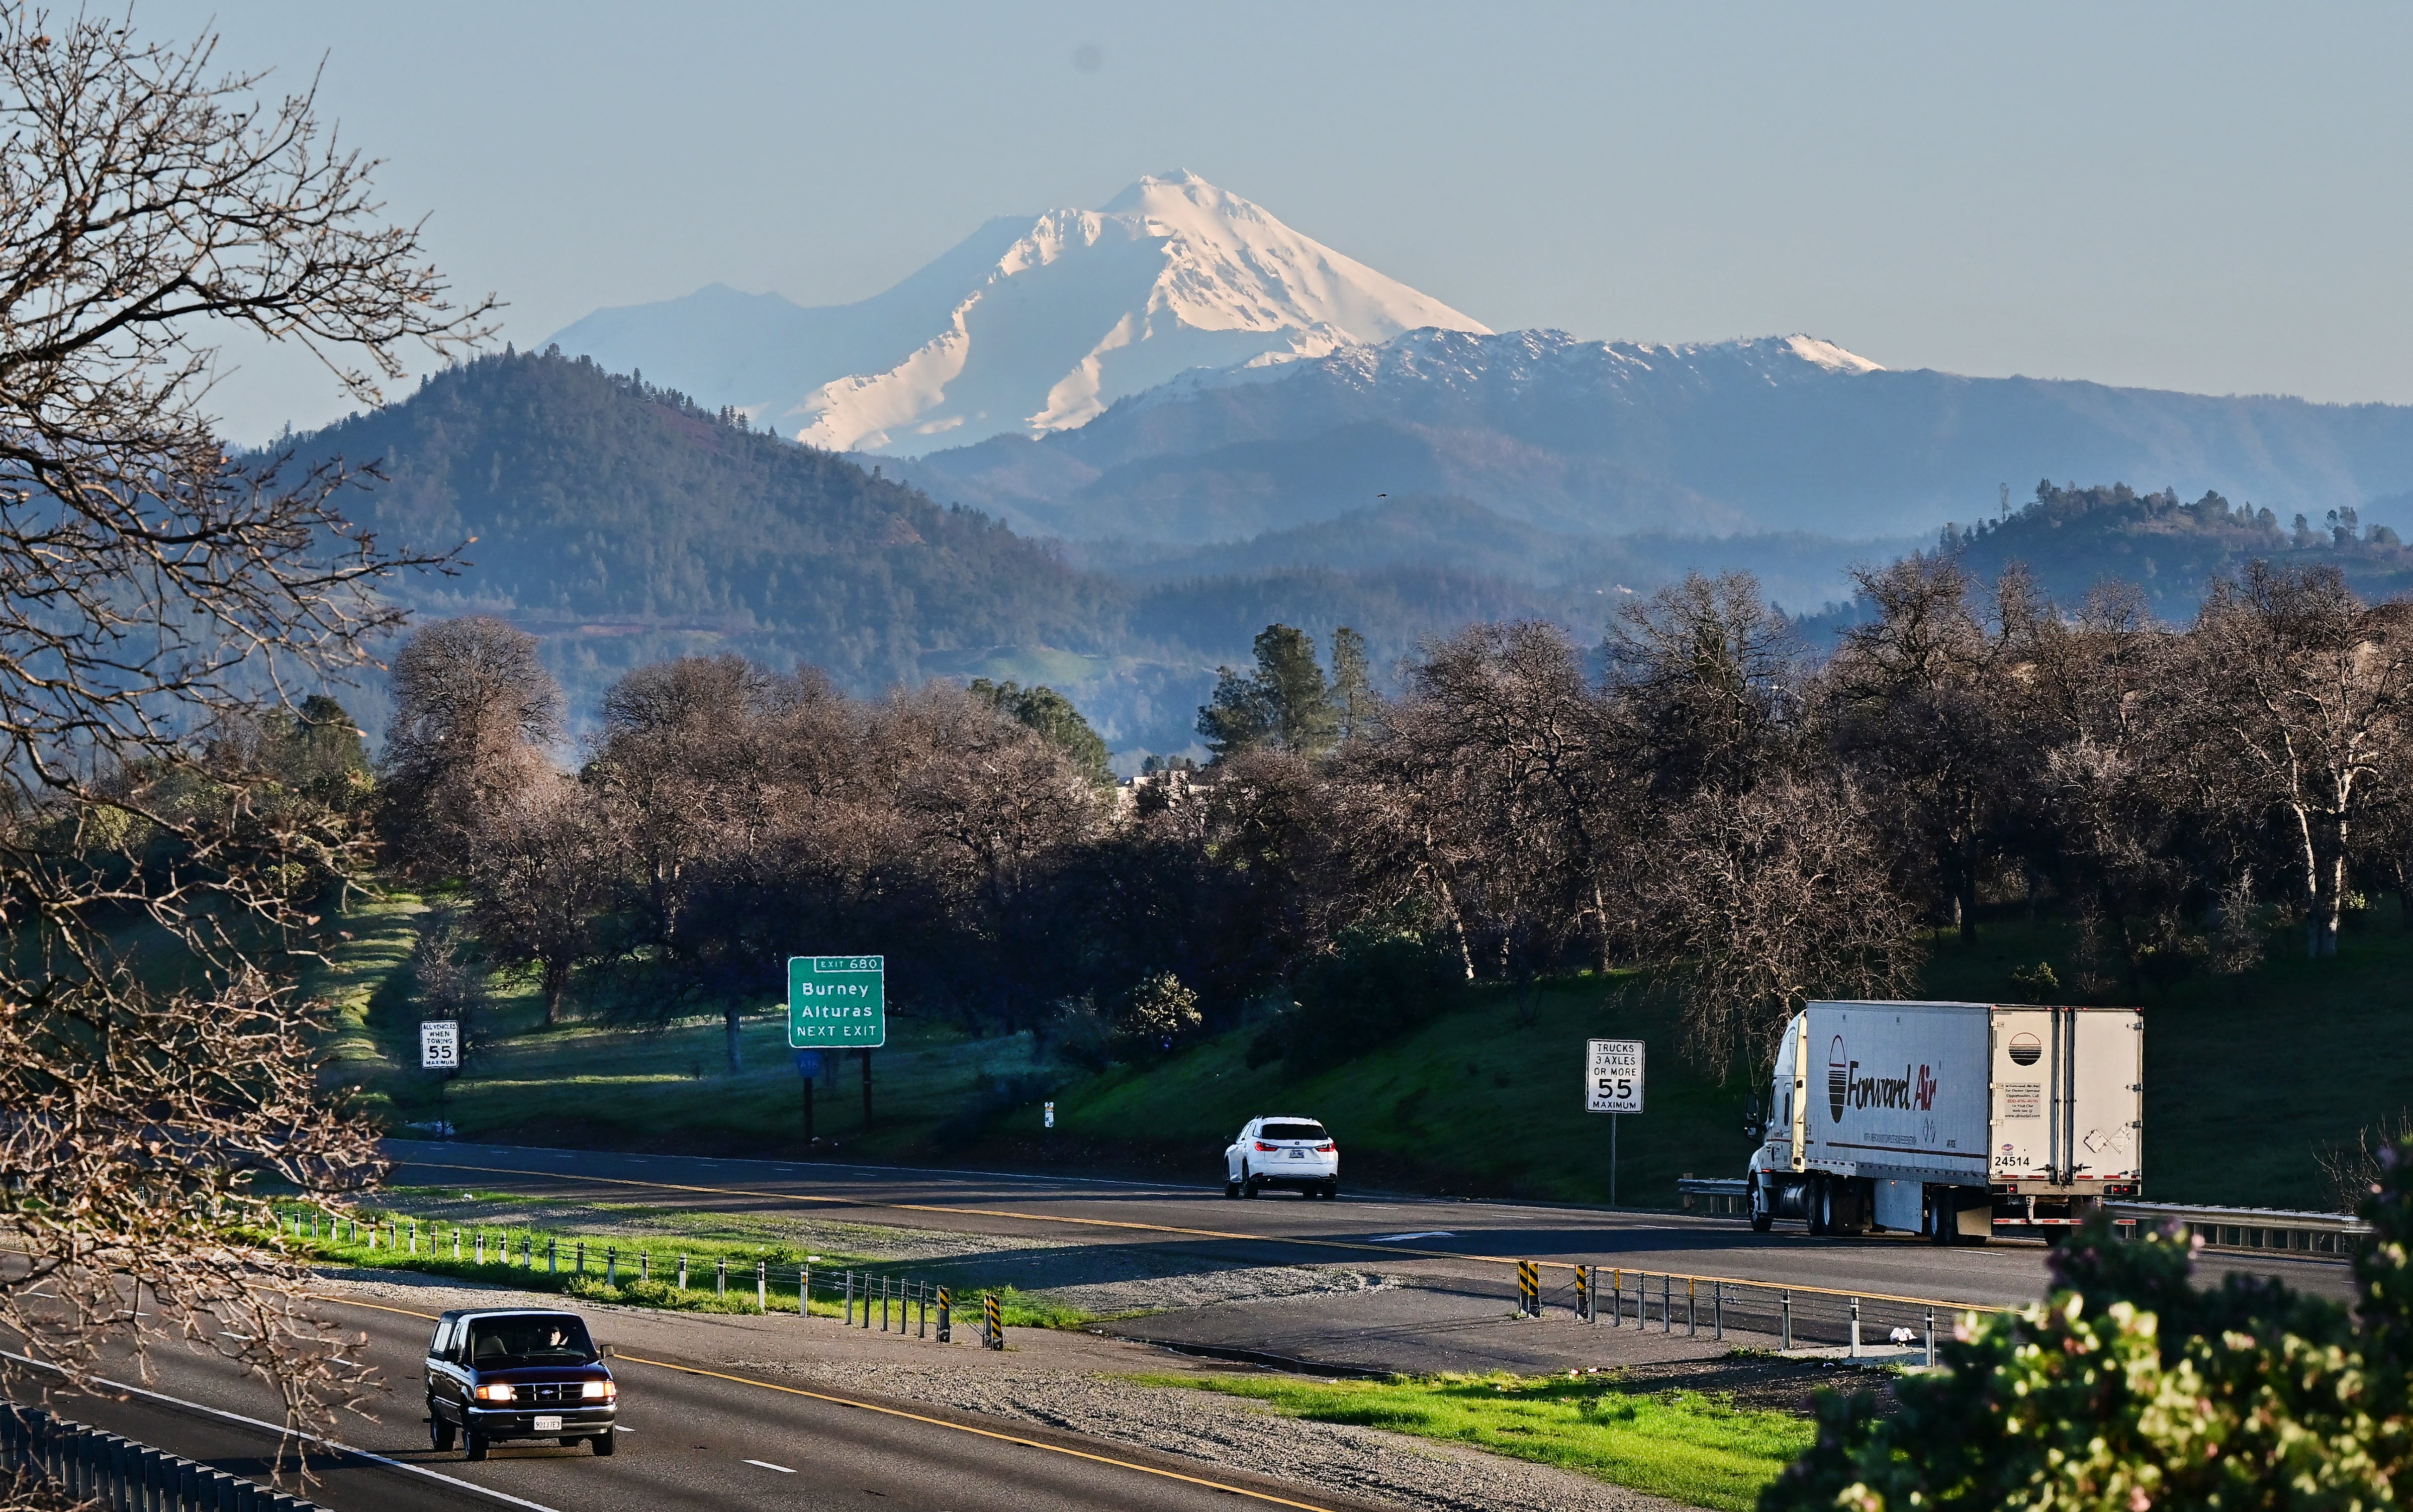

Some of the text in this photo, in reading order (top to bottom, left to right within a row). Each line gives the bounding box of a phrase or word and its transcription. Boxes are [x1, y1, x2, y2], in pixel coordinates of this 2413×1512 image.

[850, 959, 877, 969] 680
[802, 982, 869, 998] Burney
[802, 1005, 873, 1018] Alturas
[796, 1025, 876, 1036] NEXT EXIT
[429, 1046, 451, 1059] 55
[1597, 1044, 1634, 1053] TRUCKS
[1596, 1056, 1635, 1065] 3 AXLES
[1594, 1067, 1636, 1076] OR MORE
[1598, 1078, 1632, 1099] 55
[1847, 1060, 1937, 1111] Forward Air
[1593, 1101, 1636, 1109] MAXIMUM
[1995, 1156, 2030, 1167] 24514
